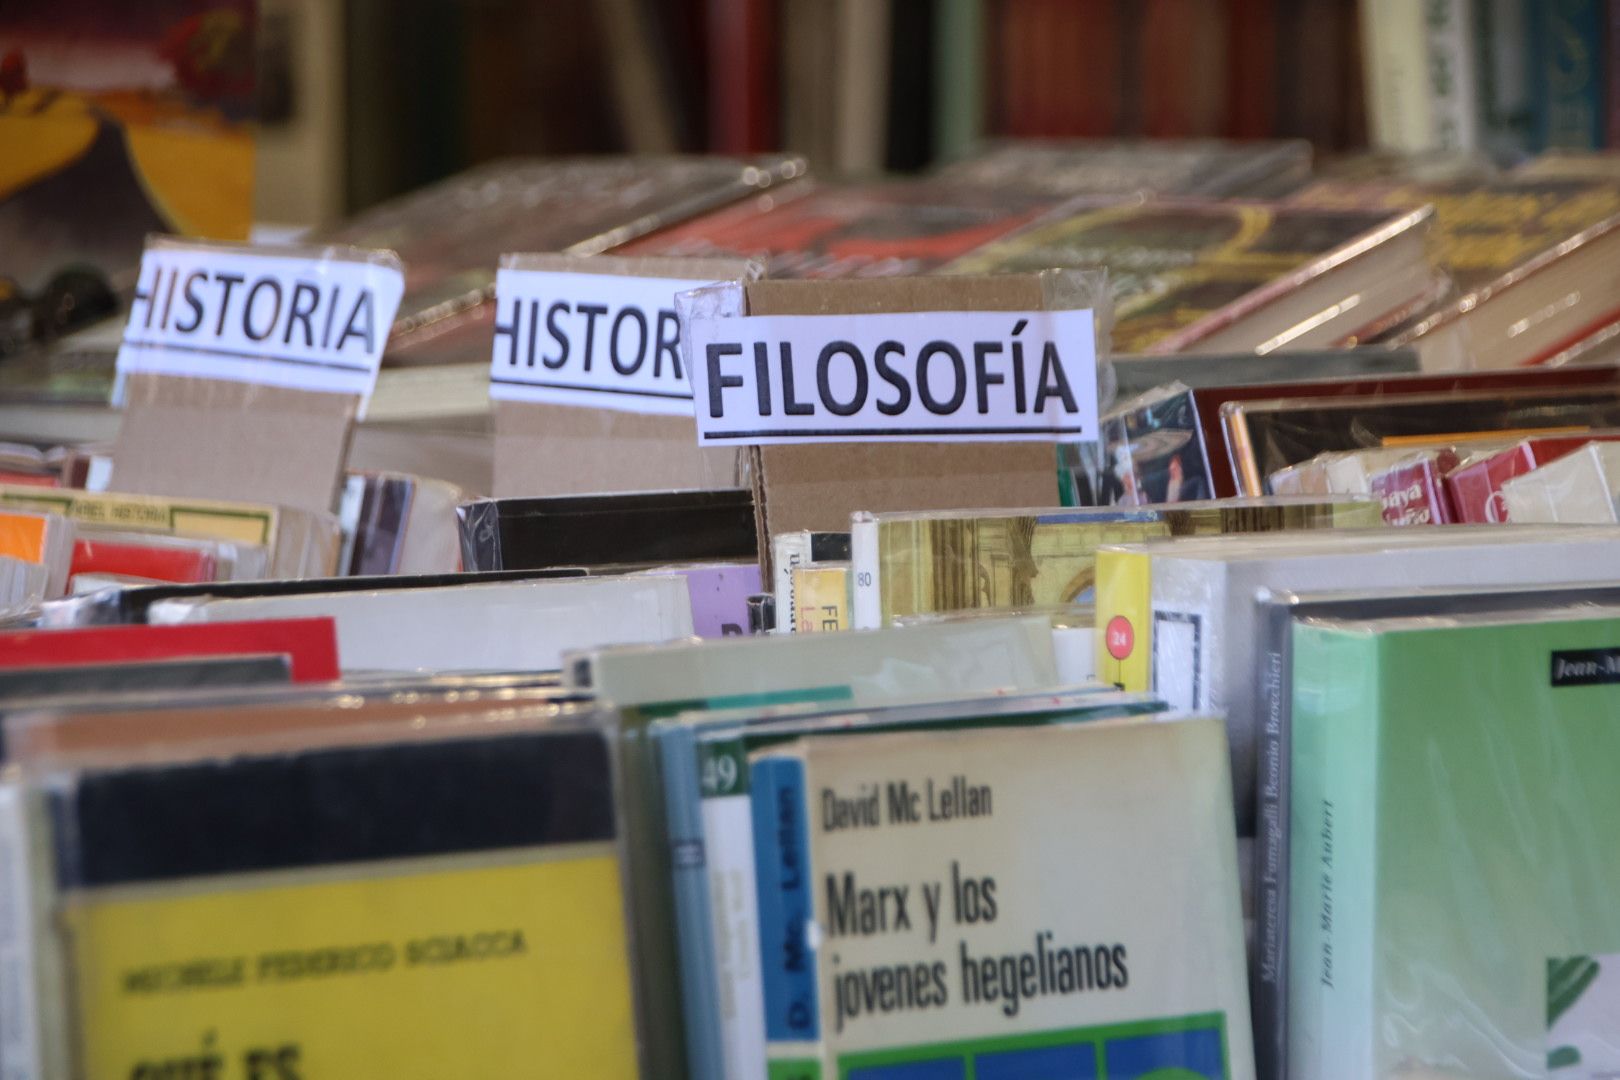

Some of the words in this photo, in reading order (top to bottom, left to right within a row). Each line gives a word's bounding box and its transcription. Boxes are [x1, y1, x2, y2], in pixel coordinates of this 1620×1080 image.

[135, 266, 375, 354] HISTORIA
[705, 319, 1080, 418] FILOSOFÍA
[857, 572, 872, 587] 80
[1112, 631, 1127, 647] 24
[702, 755, 738, 793] 49
[821, 784, 880, 832] David
[887, 780, 922, 825] Mc
[927, 775, 993, 822] Lellan
[1320, 799, 1334, 869] Aubert
[825, 870, 912, 938] Marx
[922, 881, 942, 945] y
[951, 859, 998, 925] los
[833, 952, 949, 1035] jovenes
[959, 929, 1130, 1018] hegelianos
